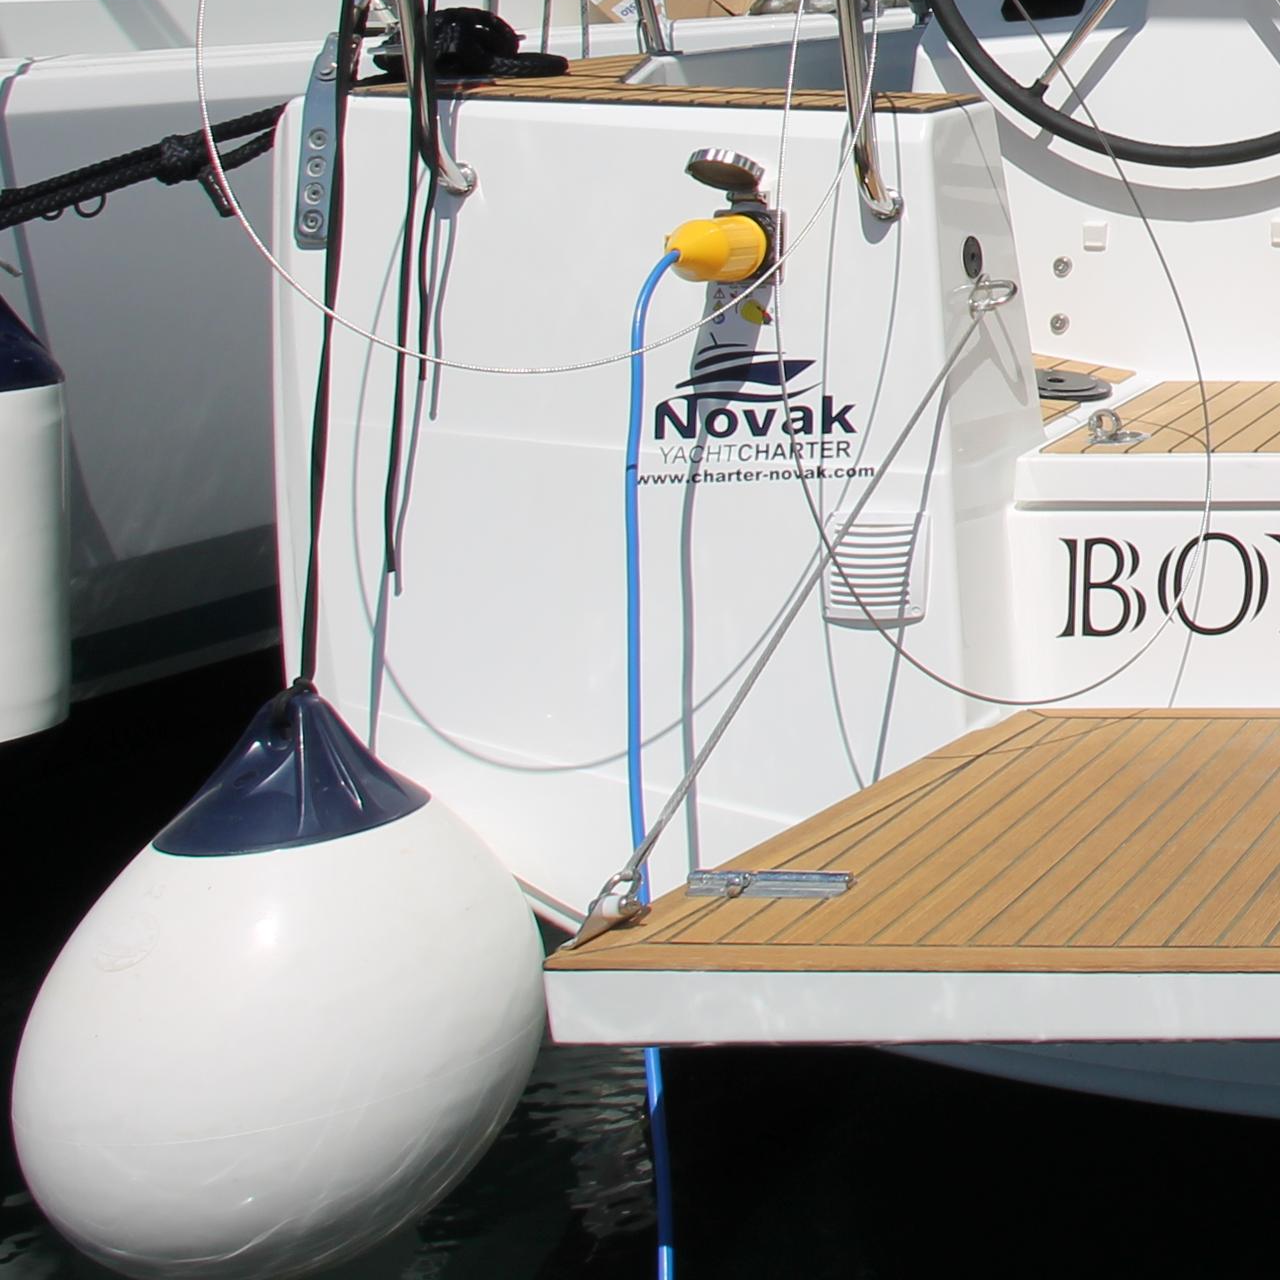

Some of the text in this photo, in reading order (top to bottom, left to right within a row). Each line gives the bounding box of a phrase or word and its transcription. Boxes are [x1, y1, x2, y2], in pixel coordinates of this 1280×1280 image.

[654, 395, 858, 440] Novak
[659, 440, 851, 464] YACHTCHARTER
[637, 465, 875, 485] www.charter-novak.com
